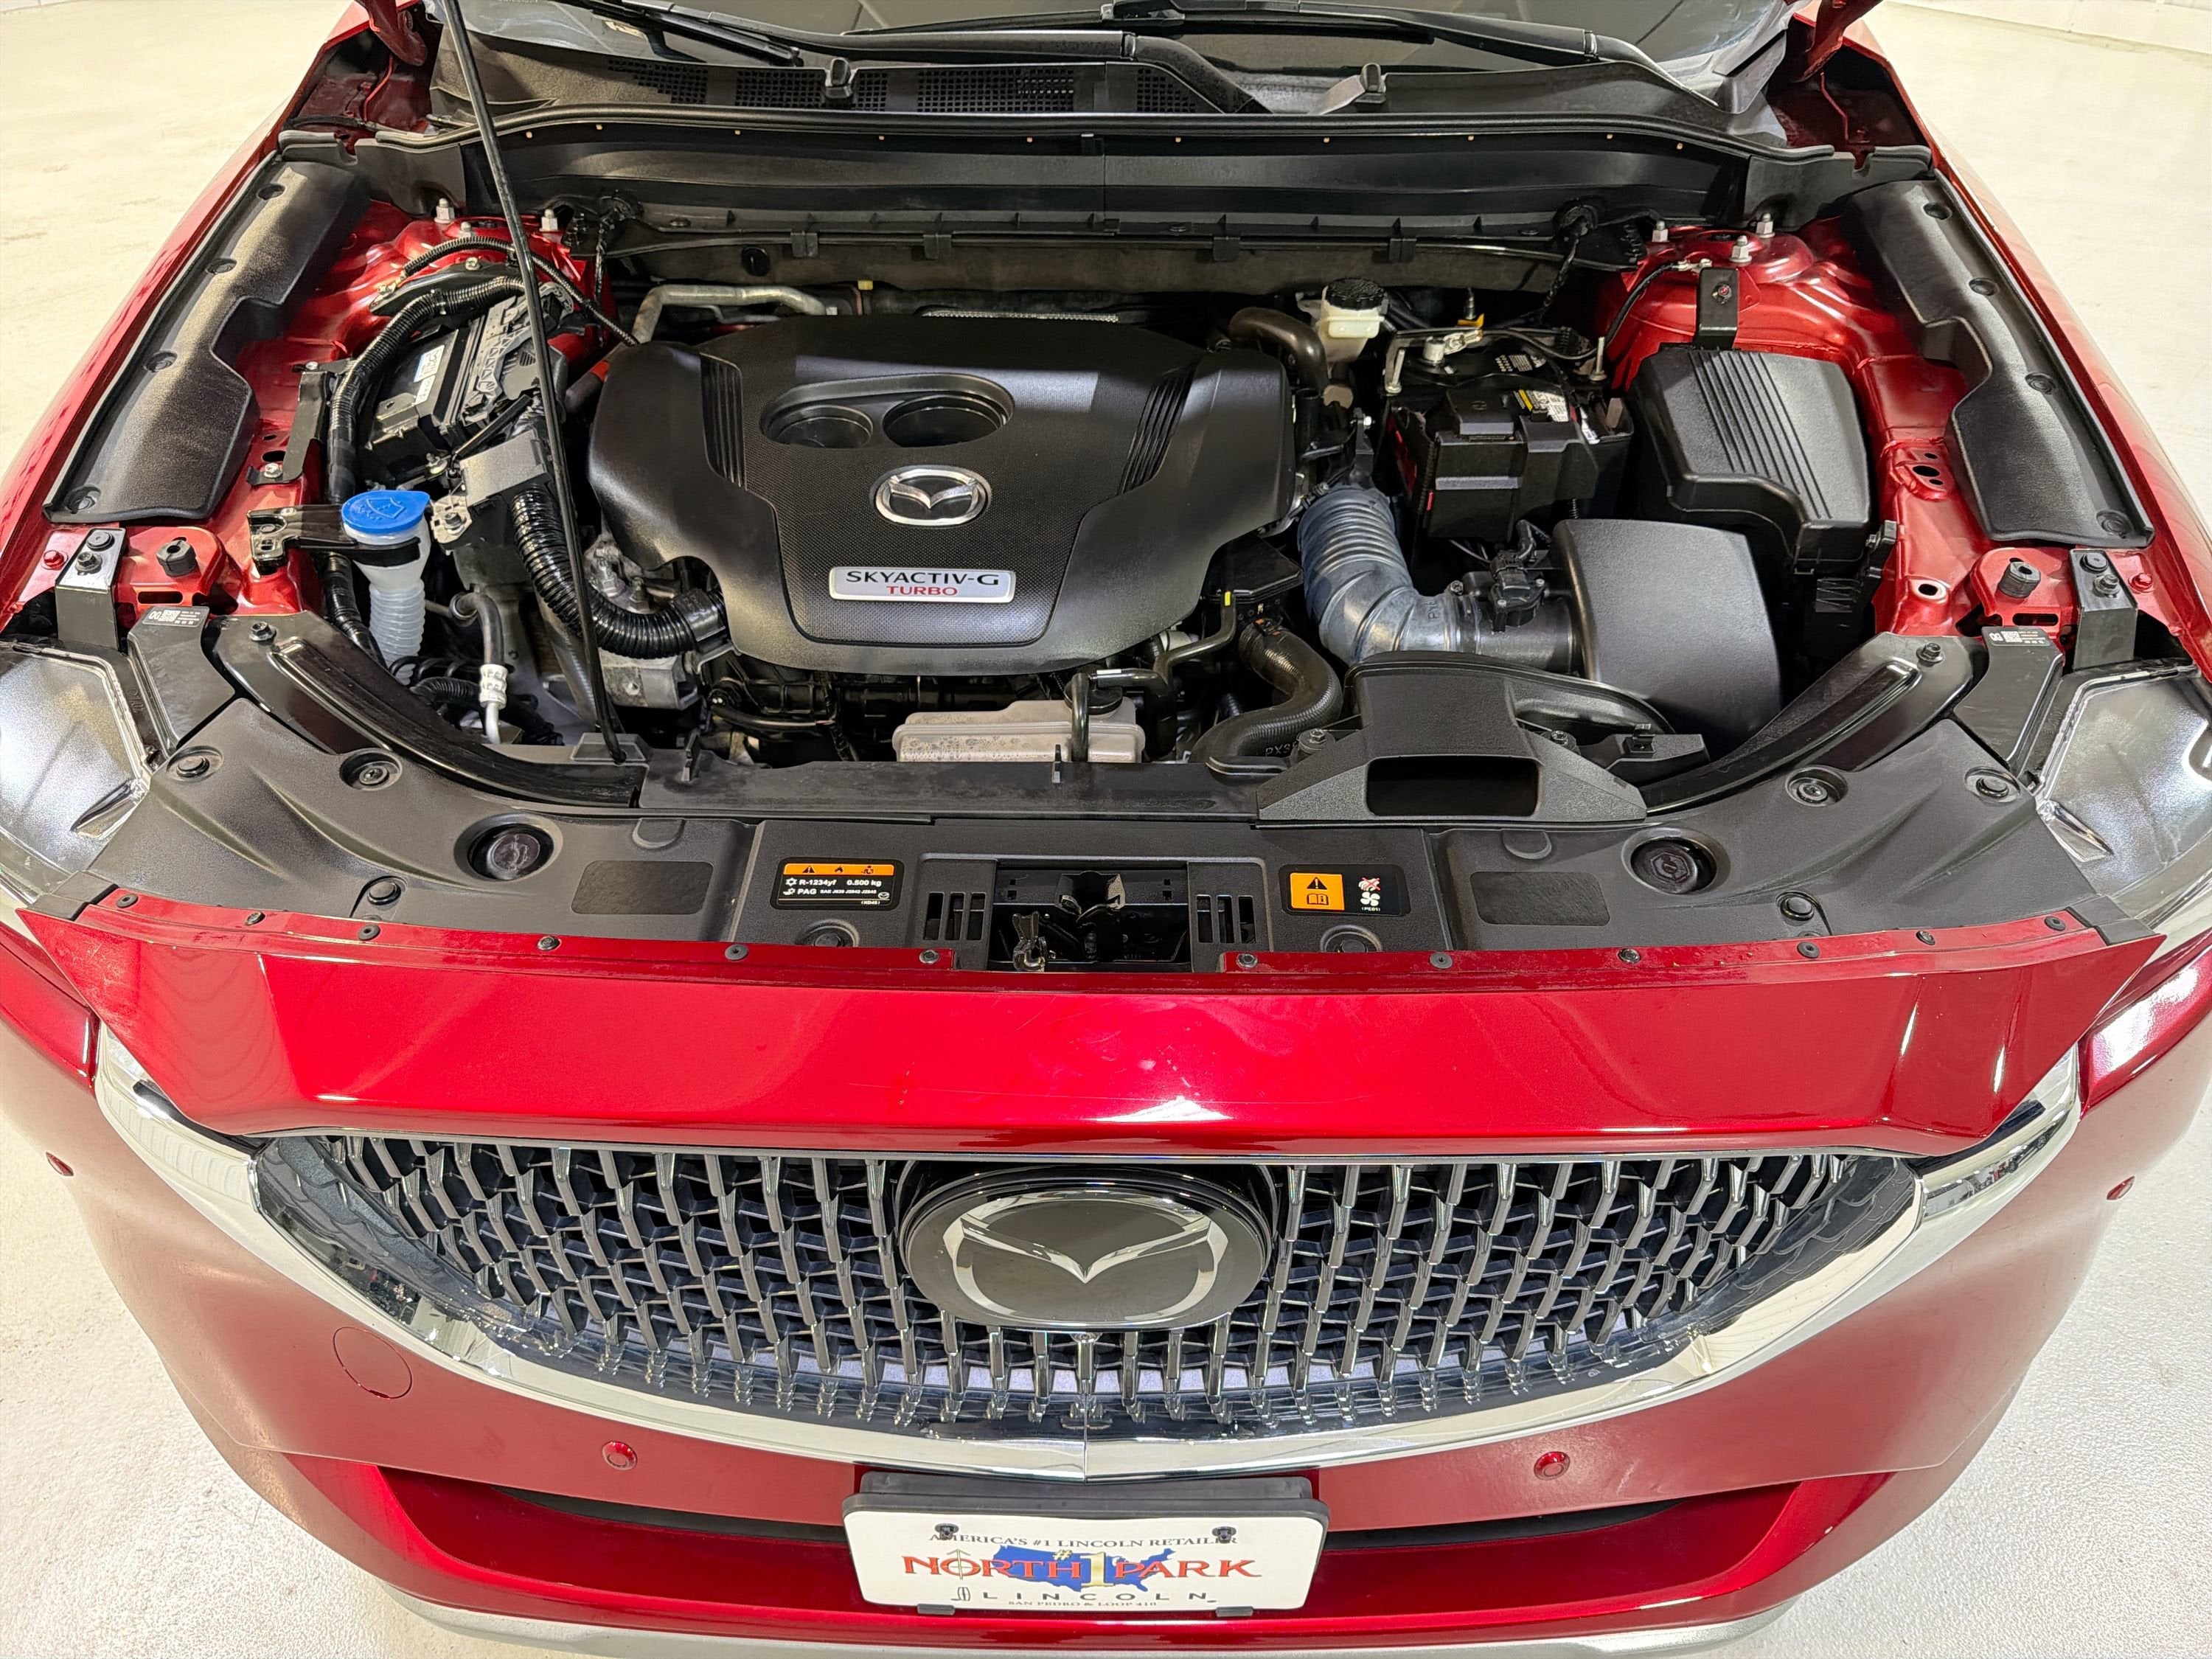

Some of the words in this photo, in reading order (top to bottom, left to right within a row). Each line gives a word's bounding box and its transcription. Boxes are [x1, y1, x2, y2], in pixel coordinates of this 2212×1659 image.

[846, 571, 1000, 585] SKYACTIV-G
[886, 586, 958, 596] TURBO
[799, 879, 837, 887] R-1234yf
[1150, 1537, 1238, 1546] RETAILR
[902, 1556, 1081, 1579] NORTH
[1115, 1559, 1262, 1579] PARK
[983, 1593, 1206, 1601] LINCOLN
